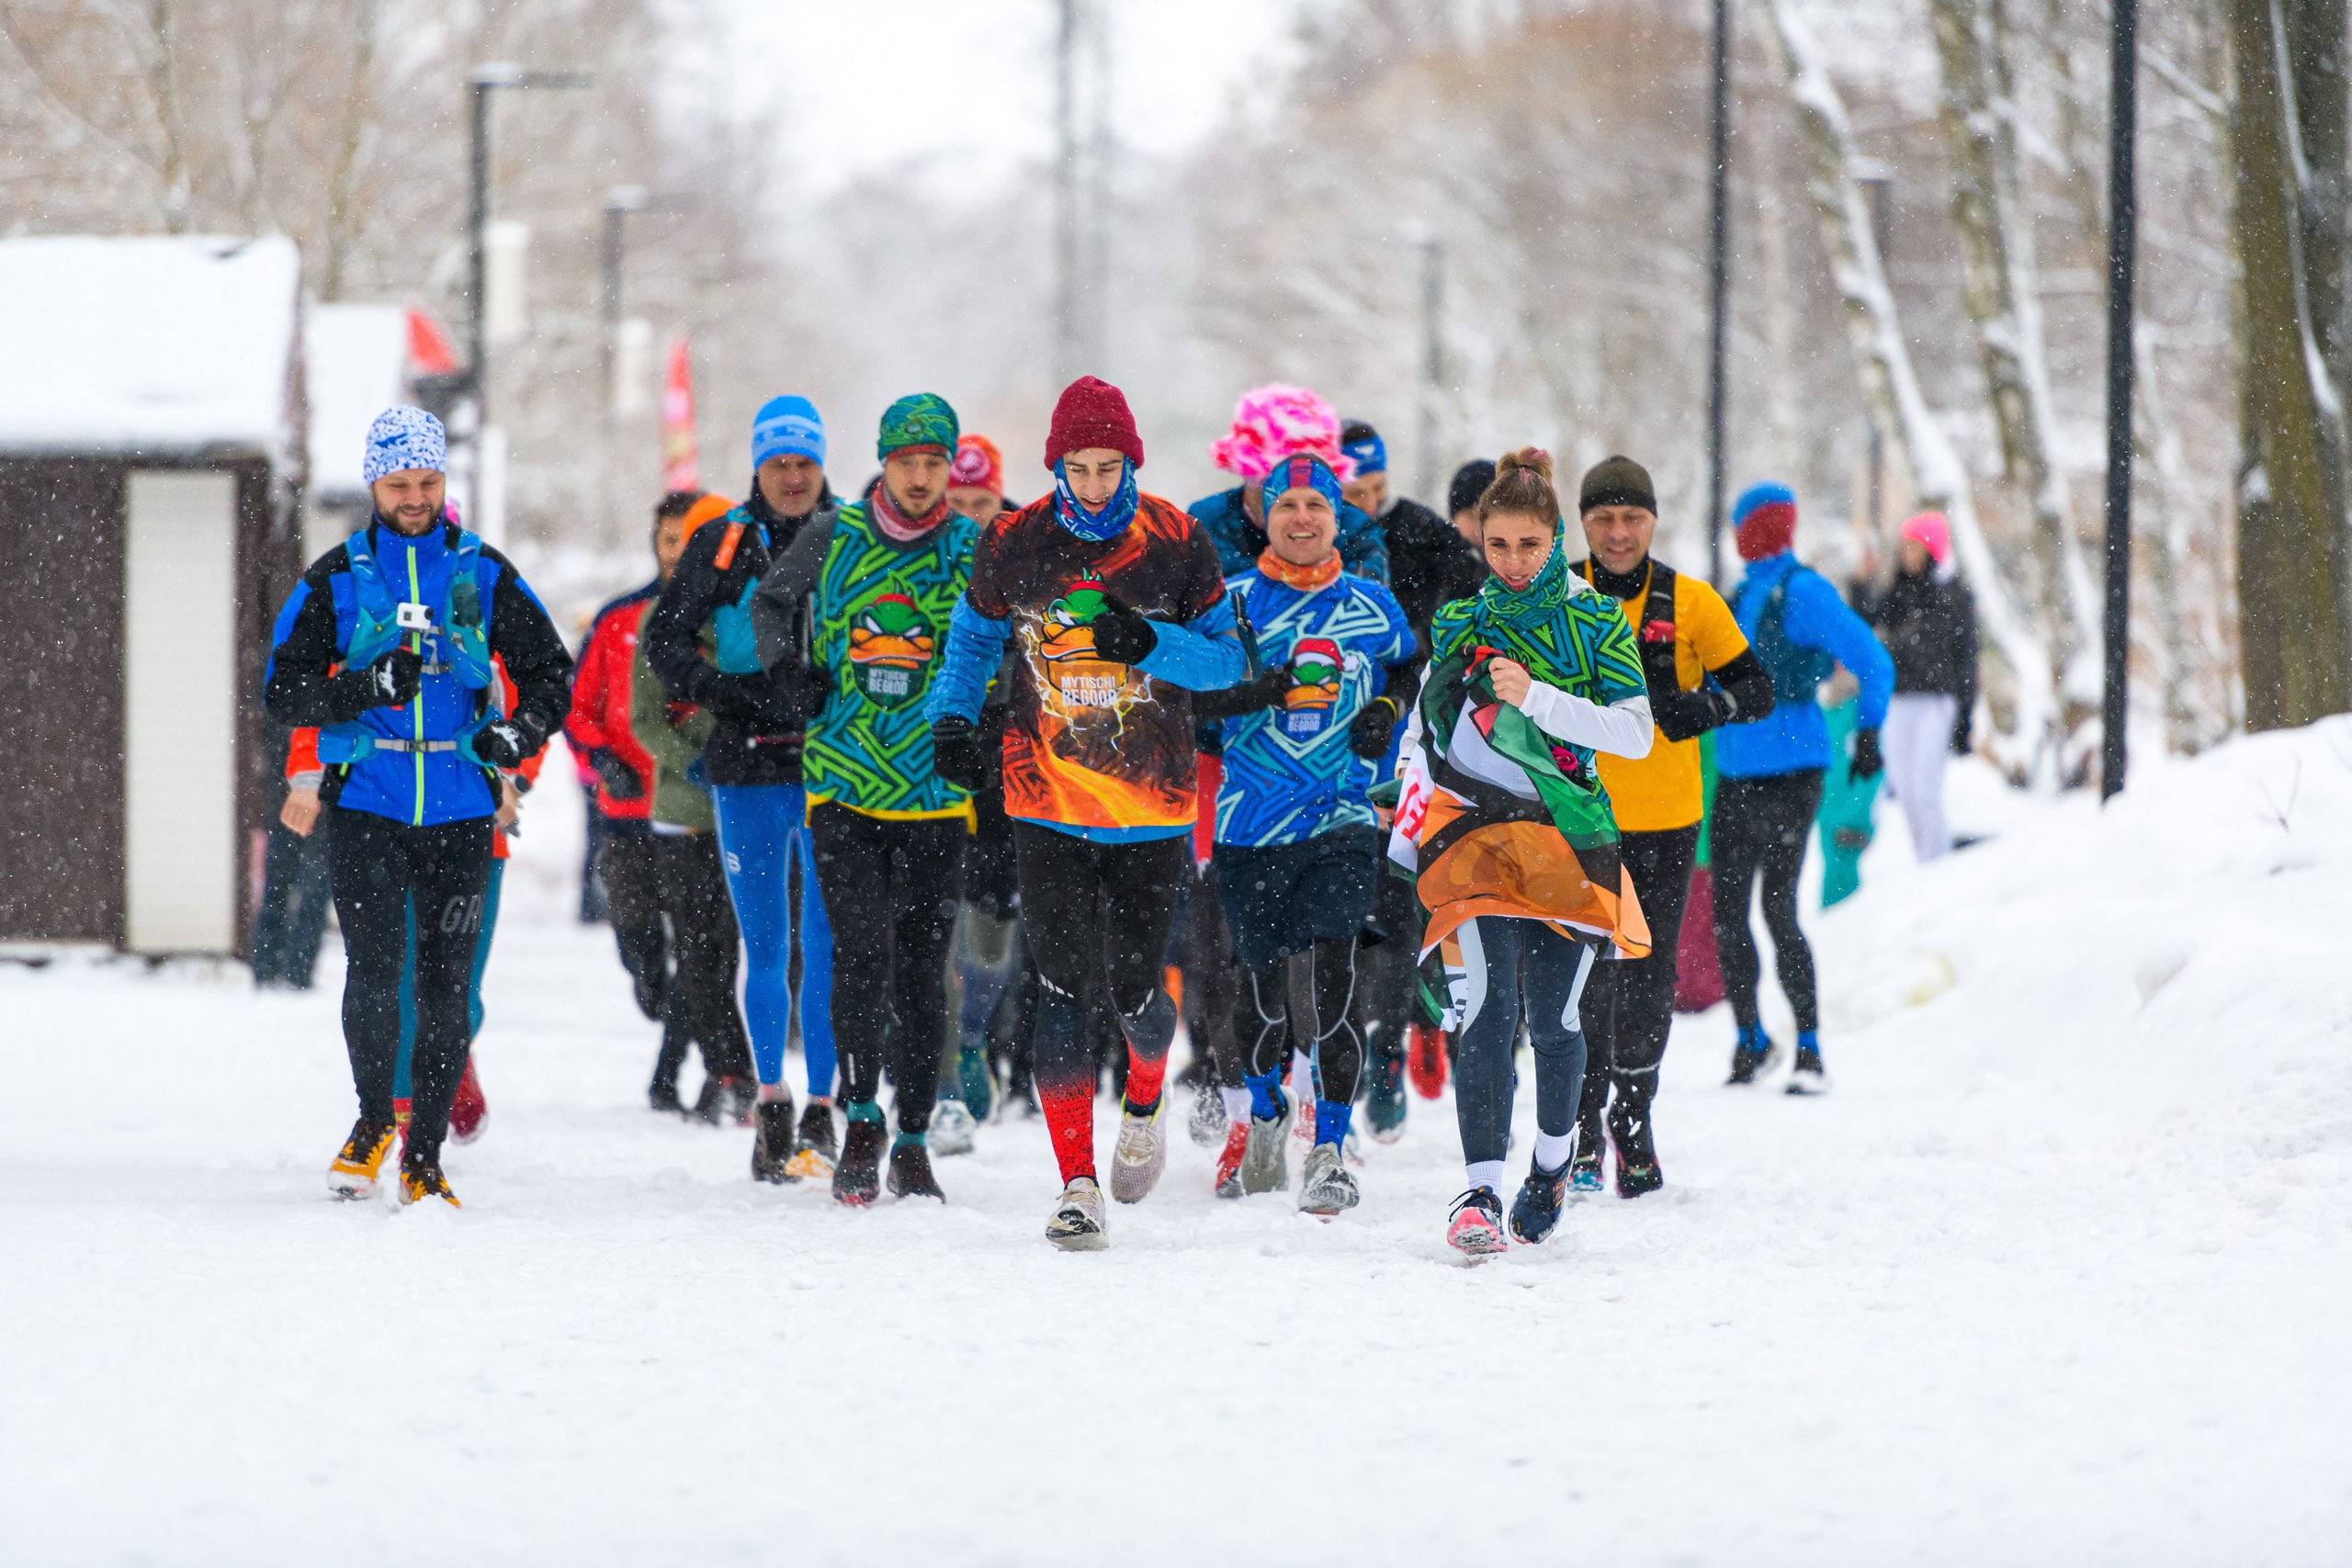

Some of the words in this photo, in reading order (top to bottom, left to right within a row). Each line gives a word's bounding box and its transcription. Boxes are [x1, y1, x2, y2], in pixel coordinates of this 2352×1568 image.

[868, 677, 909, 695] BEGOOD
[1060, 675, 1116, 689] MYTISCHI
[1061, 688, 1118, 707] BEGOOD
[1287, 720, 1320, 732] BEGOOD
